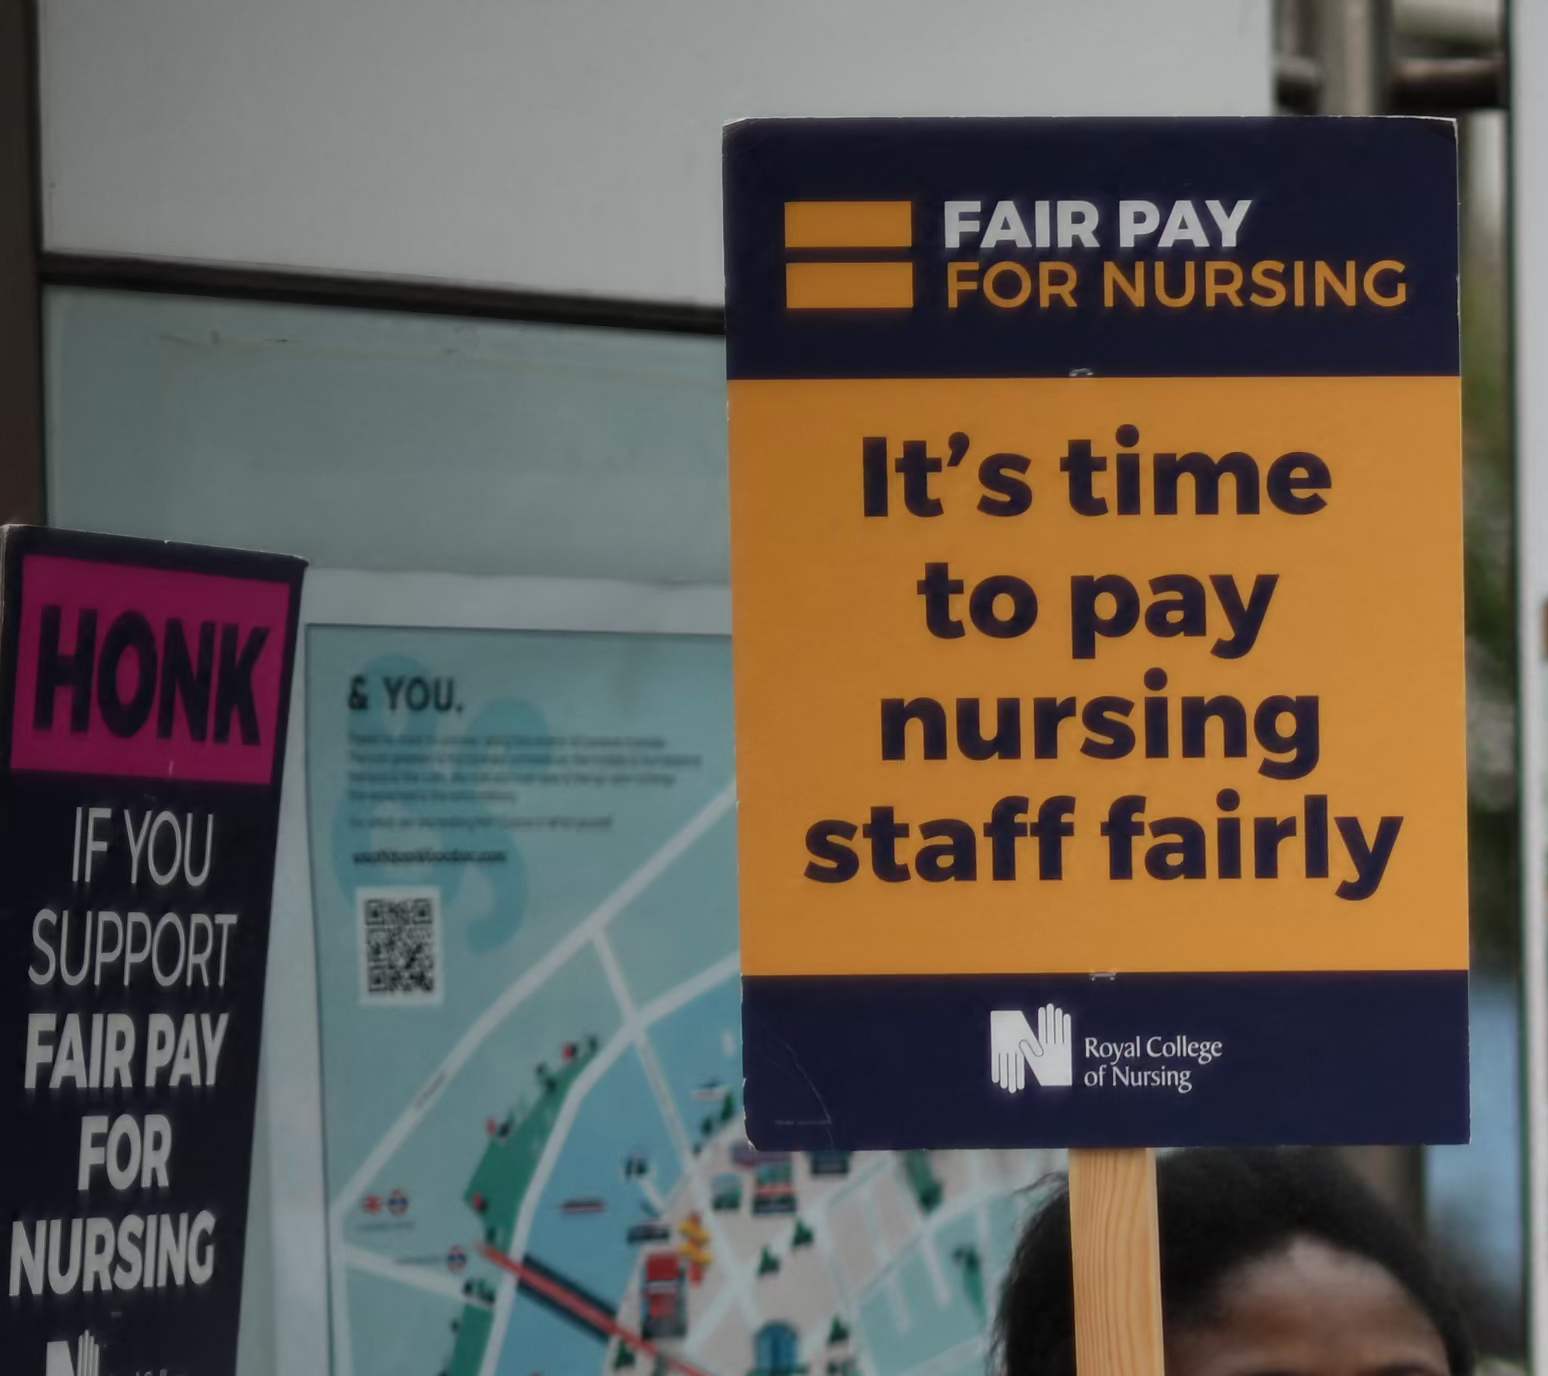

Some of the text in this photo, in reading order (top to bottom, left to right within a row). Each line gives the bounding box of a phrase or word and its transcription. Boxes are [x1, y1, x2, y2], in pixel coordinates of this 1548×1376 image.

[943, 200, 1253, 248] FAIR PAY
[947, 260, 1407, 308] FOR NURSING
[1059, 424, 1331, 517] time
[917, 562, 1280, 659] to pay
[32, 604, 270, 746] HONK
[347, 675, 463, 712] & YOU.
[880, 667, 1320, 780] nursing
[71, 806, 214, 887] IF YOU
[804, 789, 1404, 900] staff fairly
[27, 909, 238, 988] SUPPORT
[24, 1012, 230, 1089] FAIR PAY
[1083, 1064, 1193, 1094] of Nursing
[1084, 1035, 1223, 1063] Royal College
[78, 1114, 172, 1191] FOR
[8, 1210, 217, 1296] NURSING
